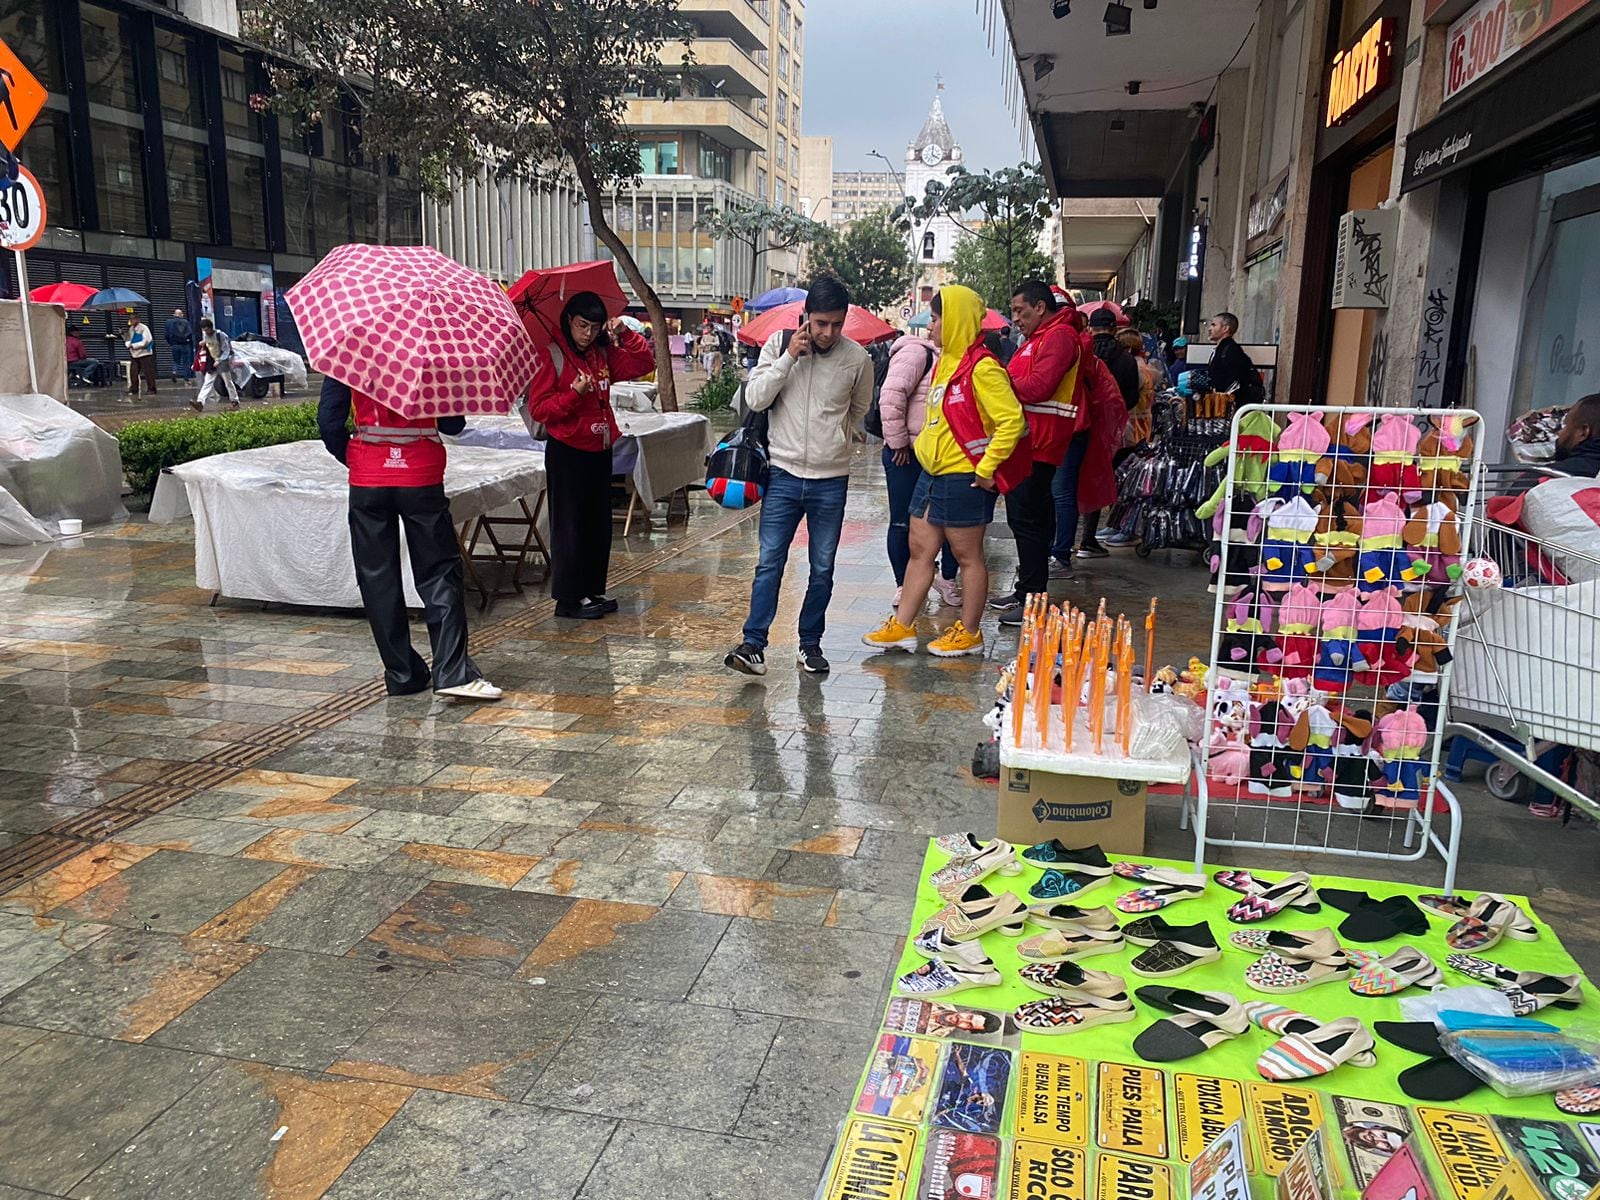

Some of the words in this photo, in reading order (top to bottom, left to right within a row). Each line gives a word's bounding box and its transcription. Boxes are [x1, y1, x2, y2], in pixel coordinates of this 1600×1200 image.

[1447, 0, 1506, 96] 16.900
[1052, 804, 1109, 820] Colombina
[1035, 1063, 1049, 1091] BUENA
[1057, 1062, 1071, 1072] AL
[1057, 1074, 1071, 1092] MAL
[1122, 1068, 1142, 1101] PUES
[1196, 1078, 1224, 1115] TOXICA
[1033, 1093, 1048, 1124] SALSA
[1056, 1096, 1071, 1132] TIEMPO
[859, 1123, 906, 1144] LA
[1122, 1107, 1143, 1146] PAILA
[1262, 1100, 1294, 1162] VAMONOS
[1433, 1121, 1467, 1156] CON
[1050, 1148, 1075, 1188] SOLO
